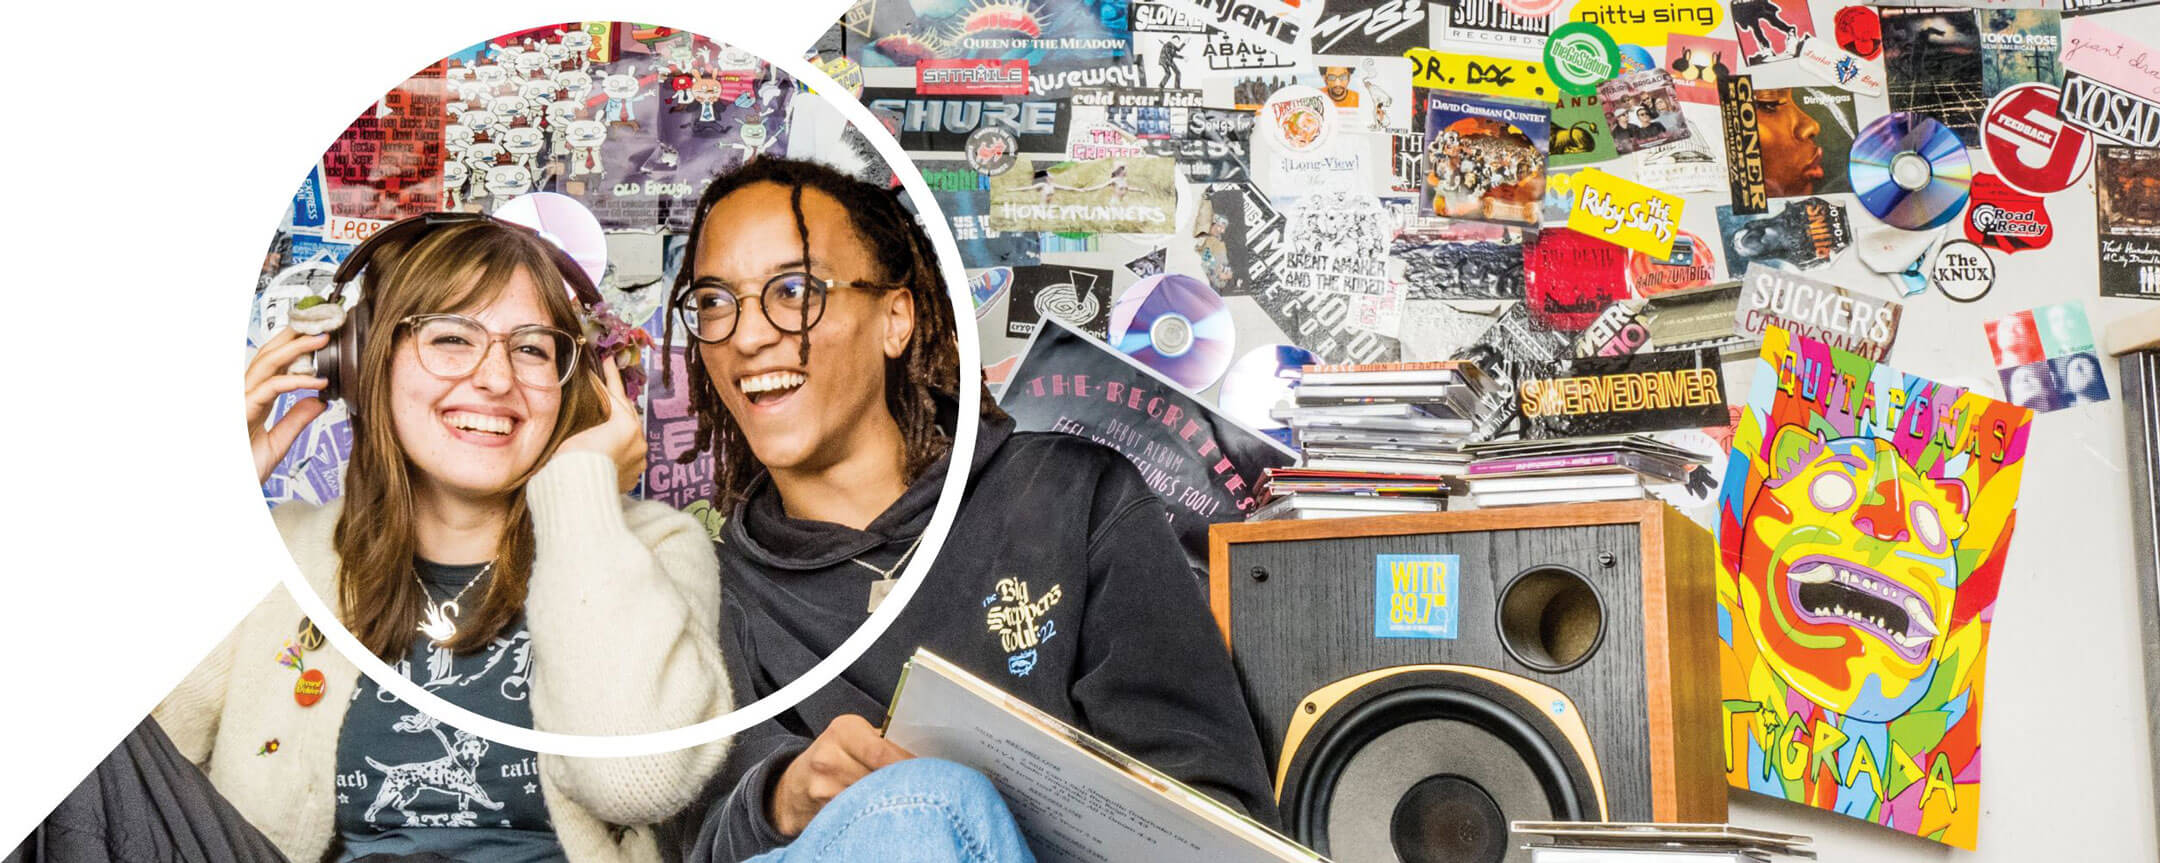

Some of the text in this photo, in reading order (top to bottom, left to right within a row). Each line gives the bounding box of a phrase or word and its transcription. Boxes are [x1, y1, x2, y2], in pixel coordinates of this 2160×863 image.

[1656, 3, 1713, 25] sing
[963, 38, 1126, 50] QUEEN OF THE MEADOW
[1453, 30, 1545, 45] RECORDS
[1982, 33, 2057, 44] TOKYO ROSE
[2064, 38, 2123, 61] giant
[1552, 41, 1610, 79] theGoStation
[1072, 91, 1202, 107] cold war kids
[1432, 99, 1546, 123] DAVID GRISMAN QUINTET
[1997, 113, 2056, 142] FEEDBACK
[1728, 82, 1750, 207] RECORDS
[1737, 76, 1767, 209] GONER
[1000, 201, 1166, 223] HONEYRUNNERS
[1580, 185, 1674, 244] Ruby Suns
[1994, 208, 2034, 221] Road
[1997, 221, 2047, 236] Ready
[1287, 252, 1386, 277] BRENT AMAKER
[1946, 254, 1978, 267] The
[1285, 272, 1311, 288] AND
[1316, 273, 1340, 290] THE
[1938, 268, 1991, 281] KNUX
[1752, 273, 1893, 343] SUCKERS
[1520, 367, 1721, 417] SWERVEDRIVER
[1776, 346, 2007, 464] QUITAPENAS
[1106, 419, 1185, 471] DEBUT ALBUM
[1178, 487, 1220, 518] FOOL!
[995, 576, 1030, 603] Big
[1390, 561, 1447, 593] WITR
[1390, 593, 1434, 624] 89.7
